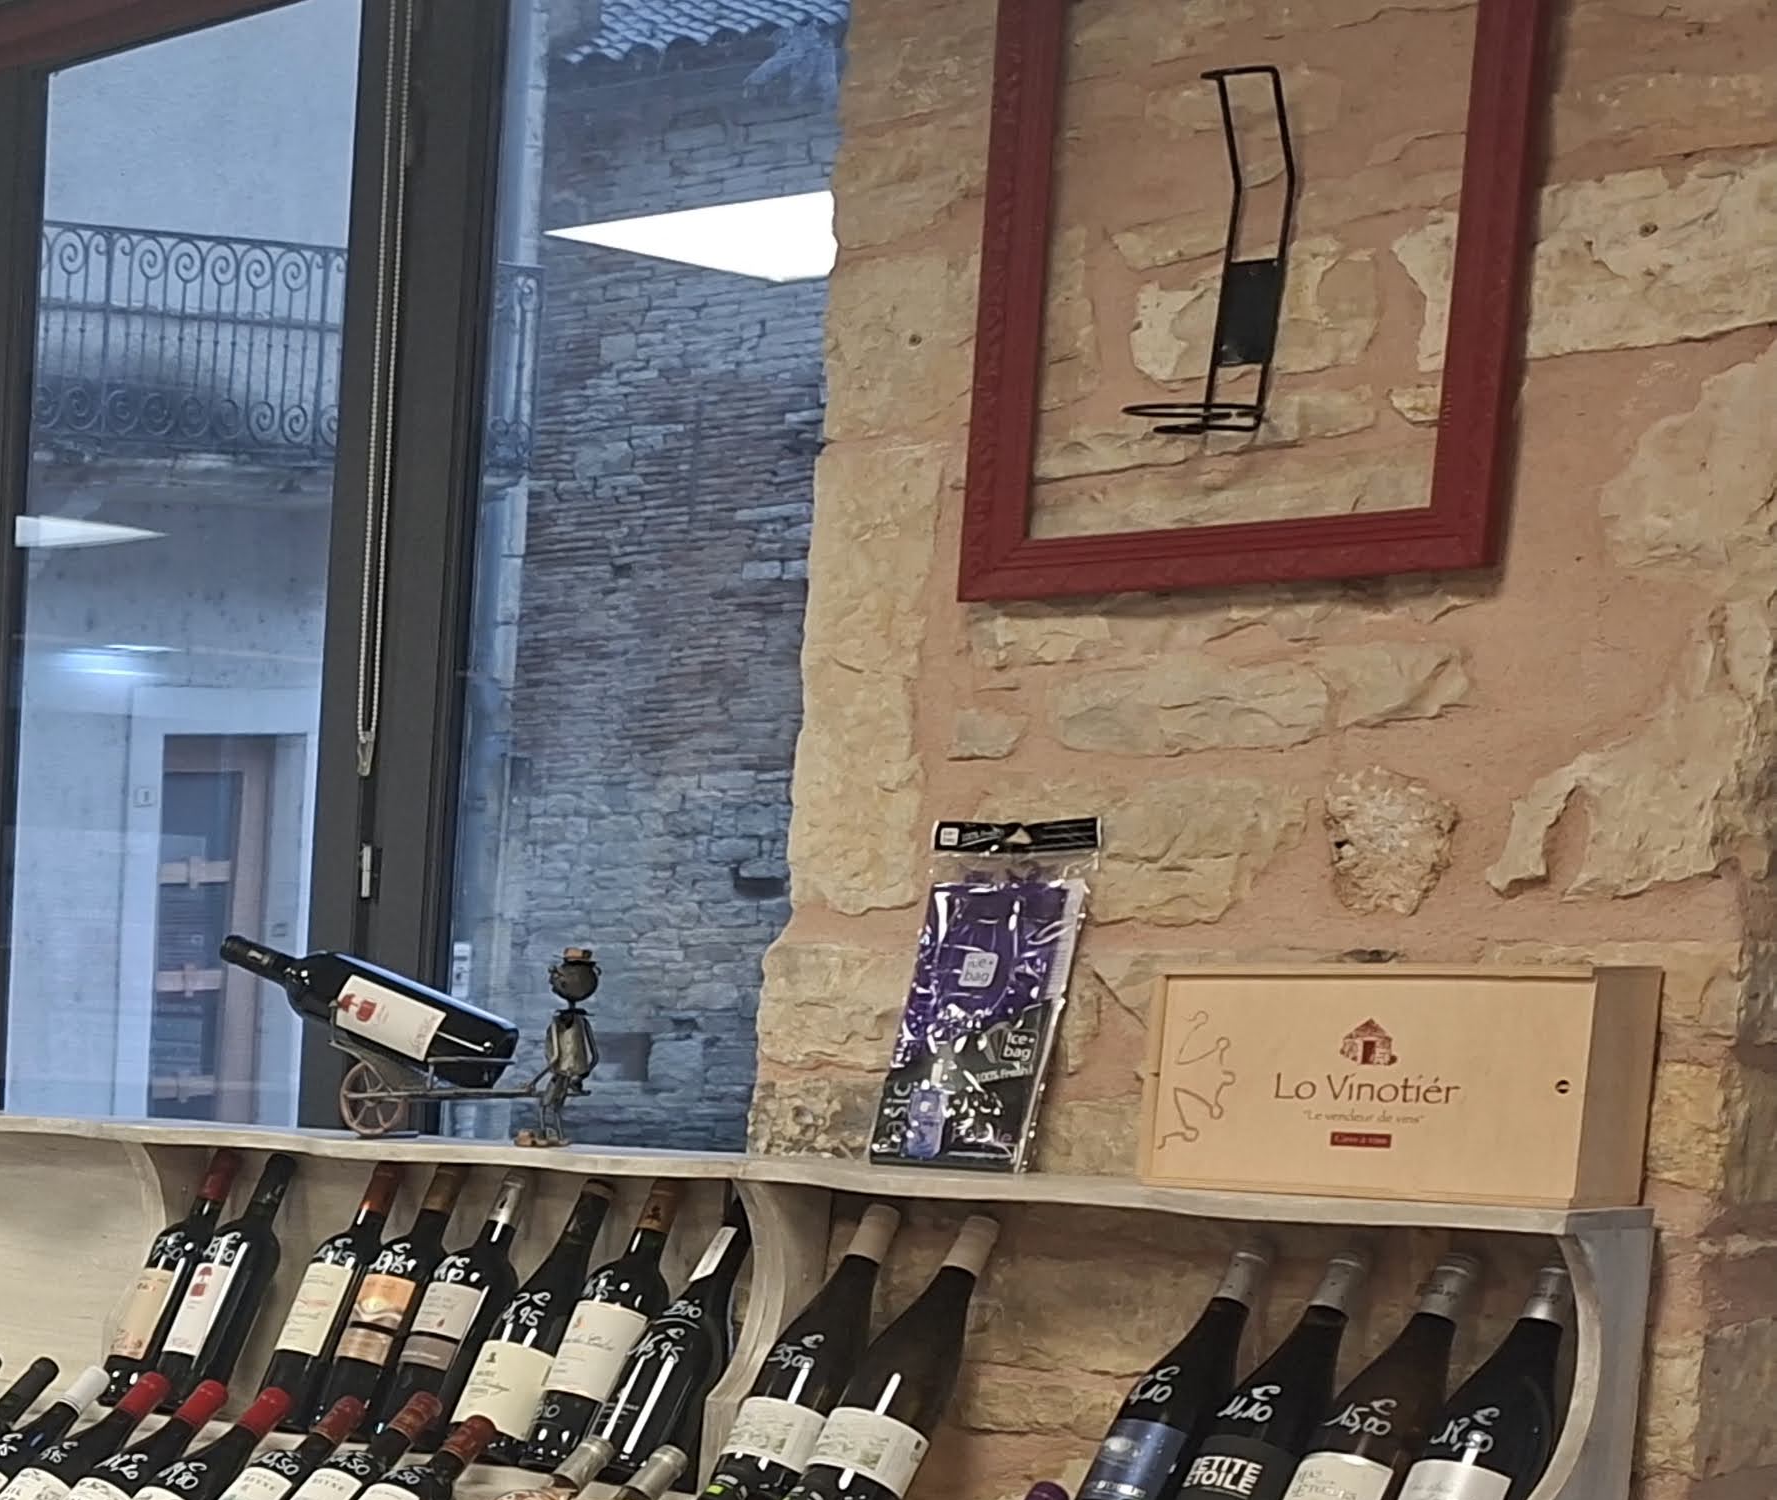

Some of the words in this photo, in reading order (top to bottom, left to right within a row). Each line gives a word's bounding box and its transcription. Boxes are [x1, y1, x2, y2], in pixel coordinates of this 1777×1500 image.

[1003, 1043, 1032, 1062] bag
[1274, 1072, 1317, 1101] Lo
[1326, 1072, 1462, 1105] Vinotiér
[1376, 1110, 1394, 1124] de
[1324, 1405, 1392, 1437] 15,00
